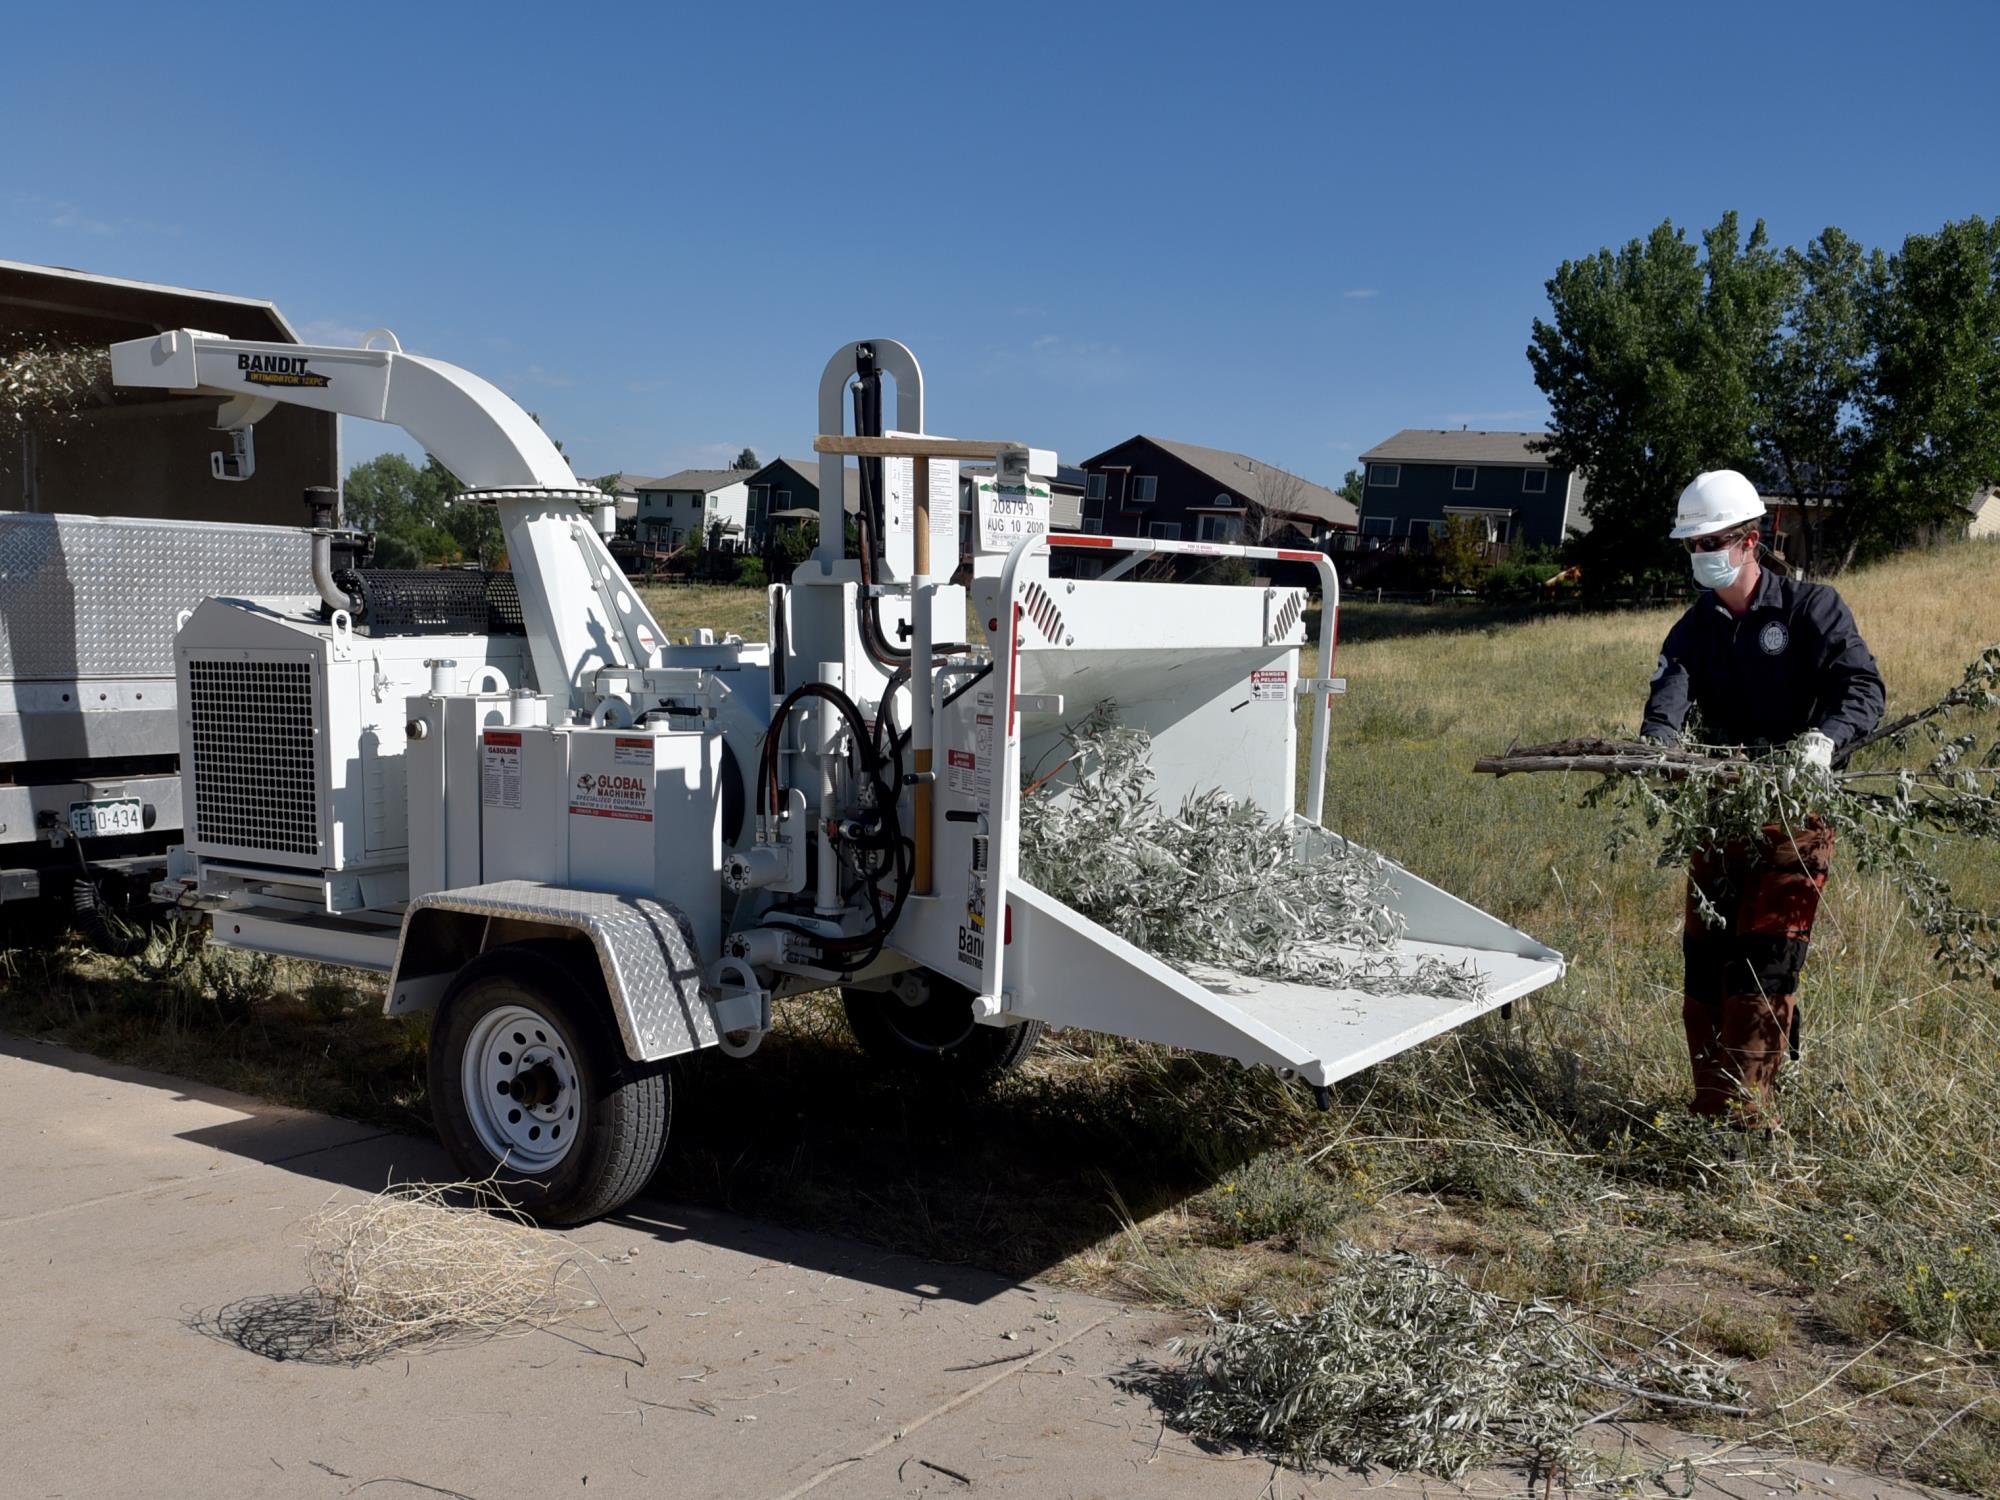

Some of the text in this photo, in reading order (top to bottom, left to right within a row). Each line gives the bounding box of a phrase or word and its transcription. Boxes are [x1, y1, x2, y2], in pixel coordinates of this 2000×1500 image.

[238, 354, 309, 374] BANDIT
[993, 499, 1034, 516] 2087939
[988, 517, 1044, 534] AUG 10 2020
[488, 746, 518, 755] GASOLINE
[598, 775, 646, 791] GLOBAL
[576, 795, 611, 803] SPECIALIZED
[597, 788, 646, 800] MACHINERY
